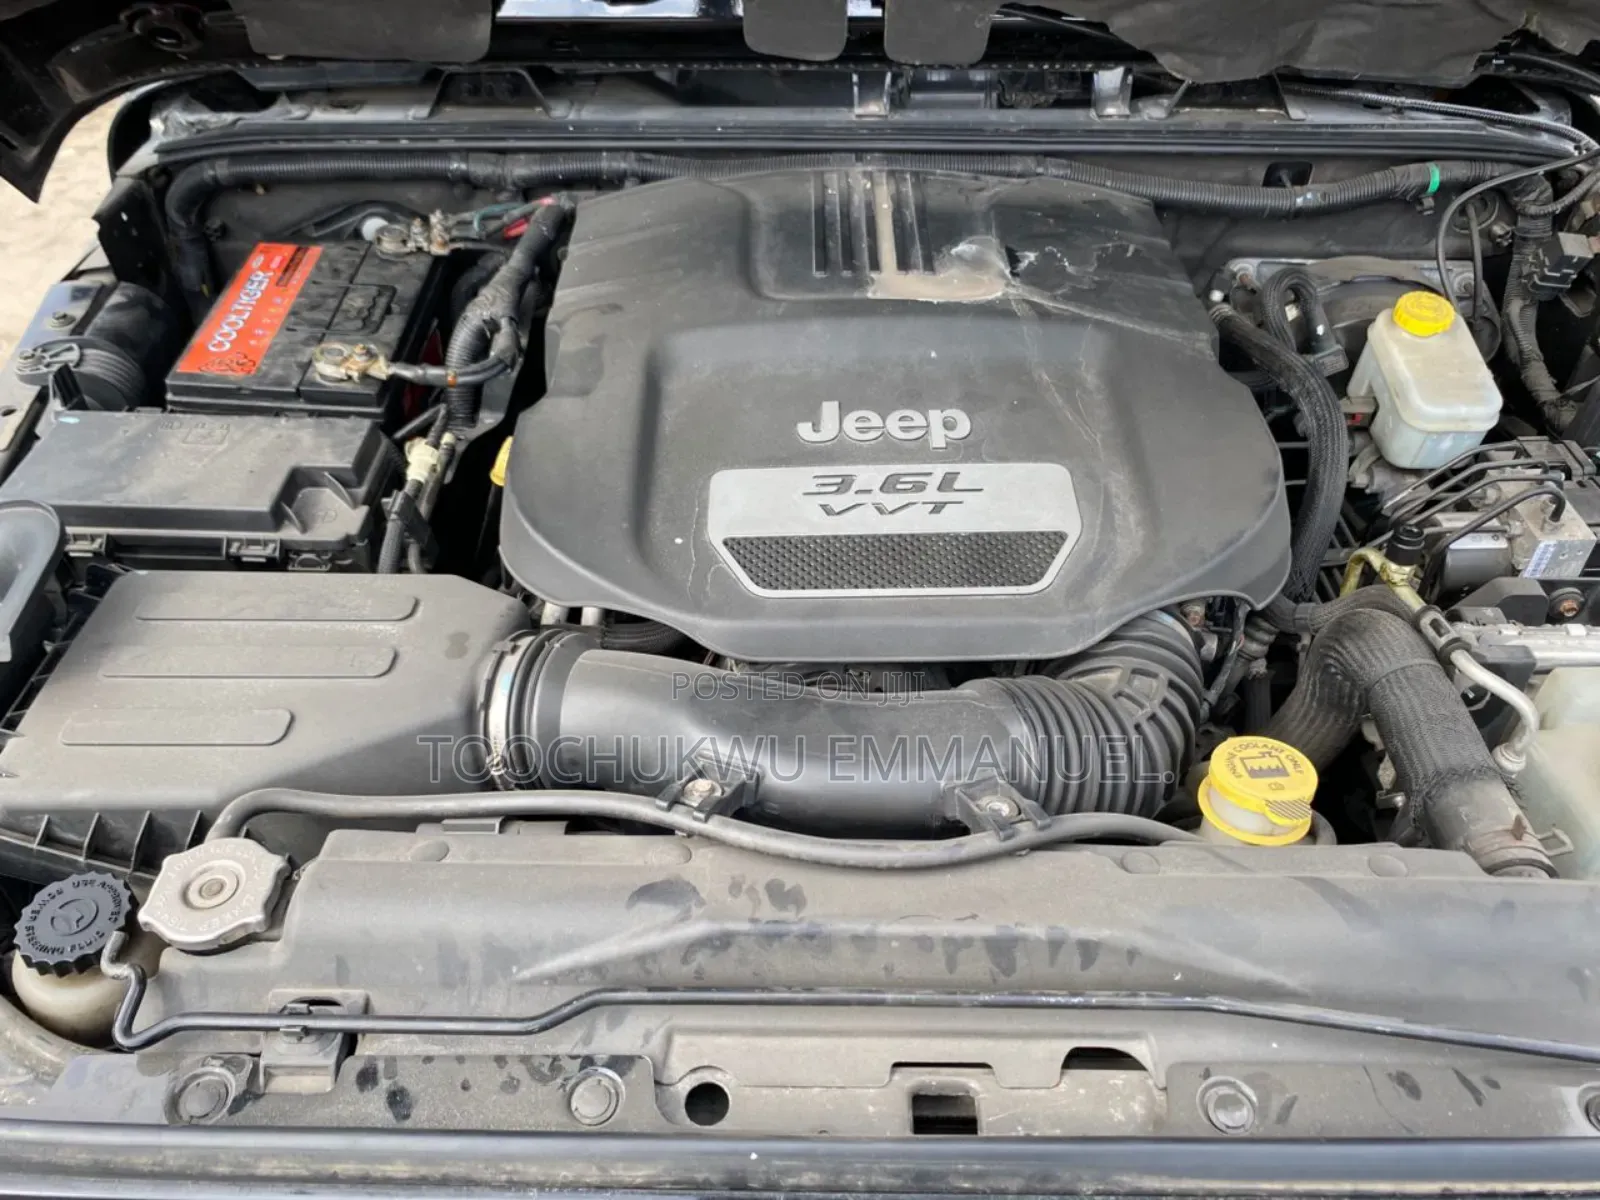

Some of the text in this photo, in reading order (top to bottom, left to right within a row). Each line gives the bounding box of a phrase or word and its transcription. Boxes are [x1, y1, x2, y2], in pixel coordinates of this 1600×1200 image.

[208, 270, 274, 352] COOLTIGER
[796, 400, 972, 450] Jeep
[802, 471, 984, 495] 3.6L
[818, 500, 964, 516] VVT
[1233, 742, 1285, 754] COOLANT
[1285, 753, 1304, 775] ONLY
